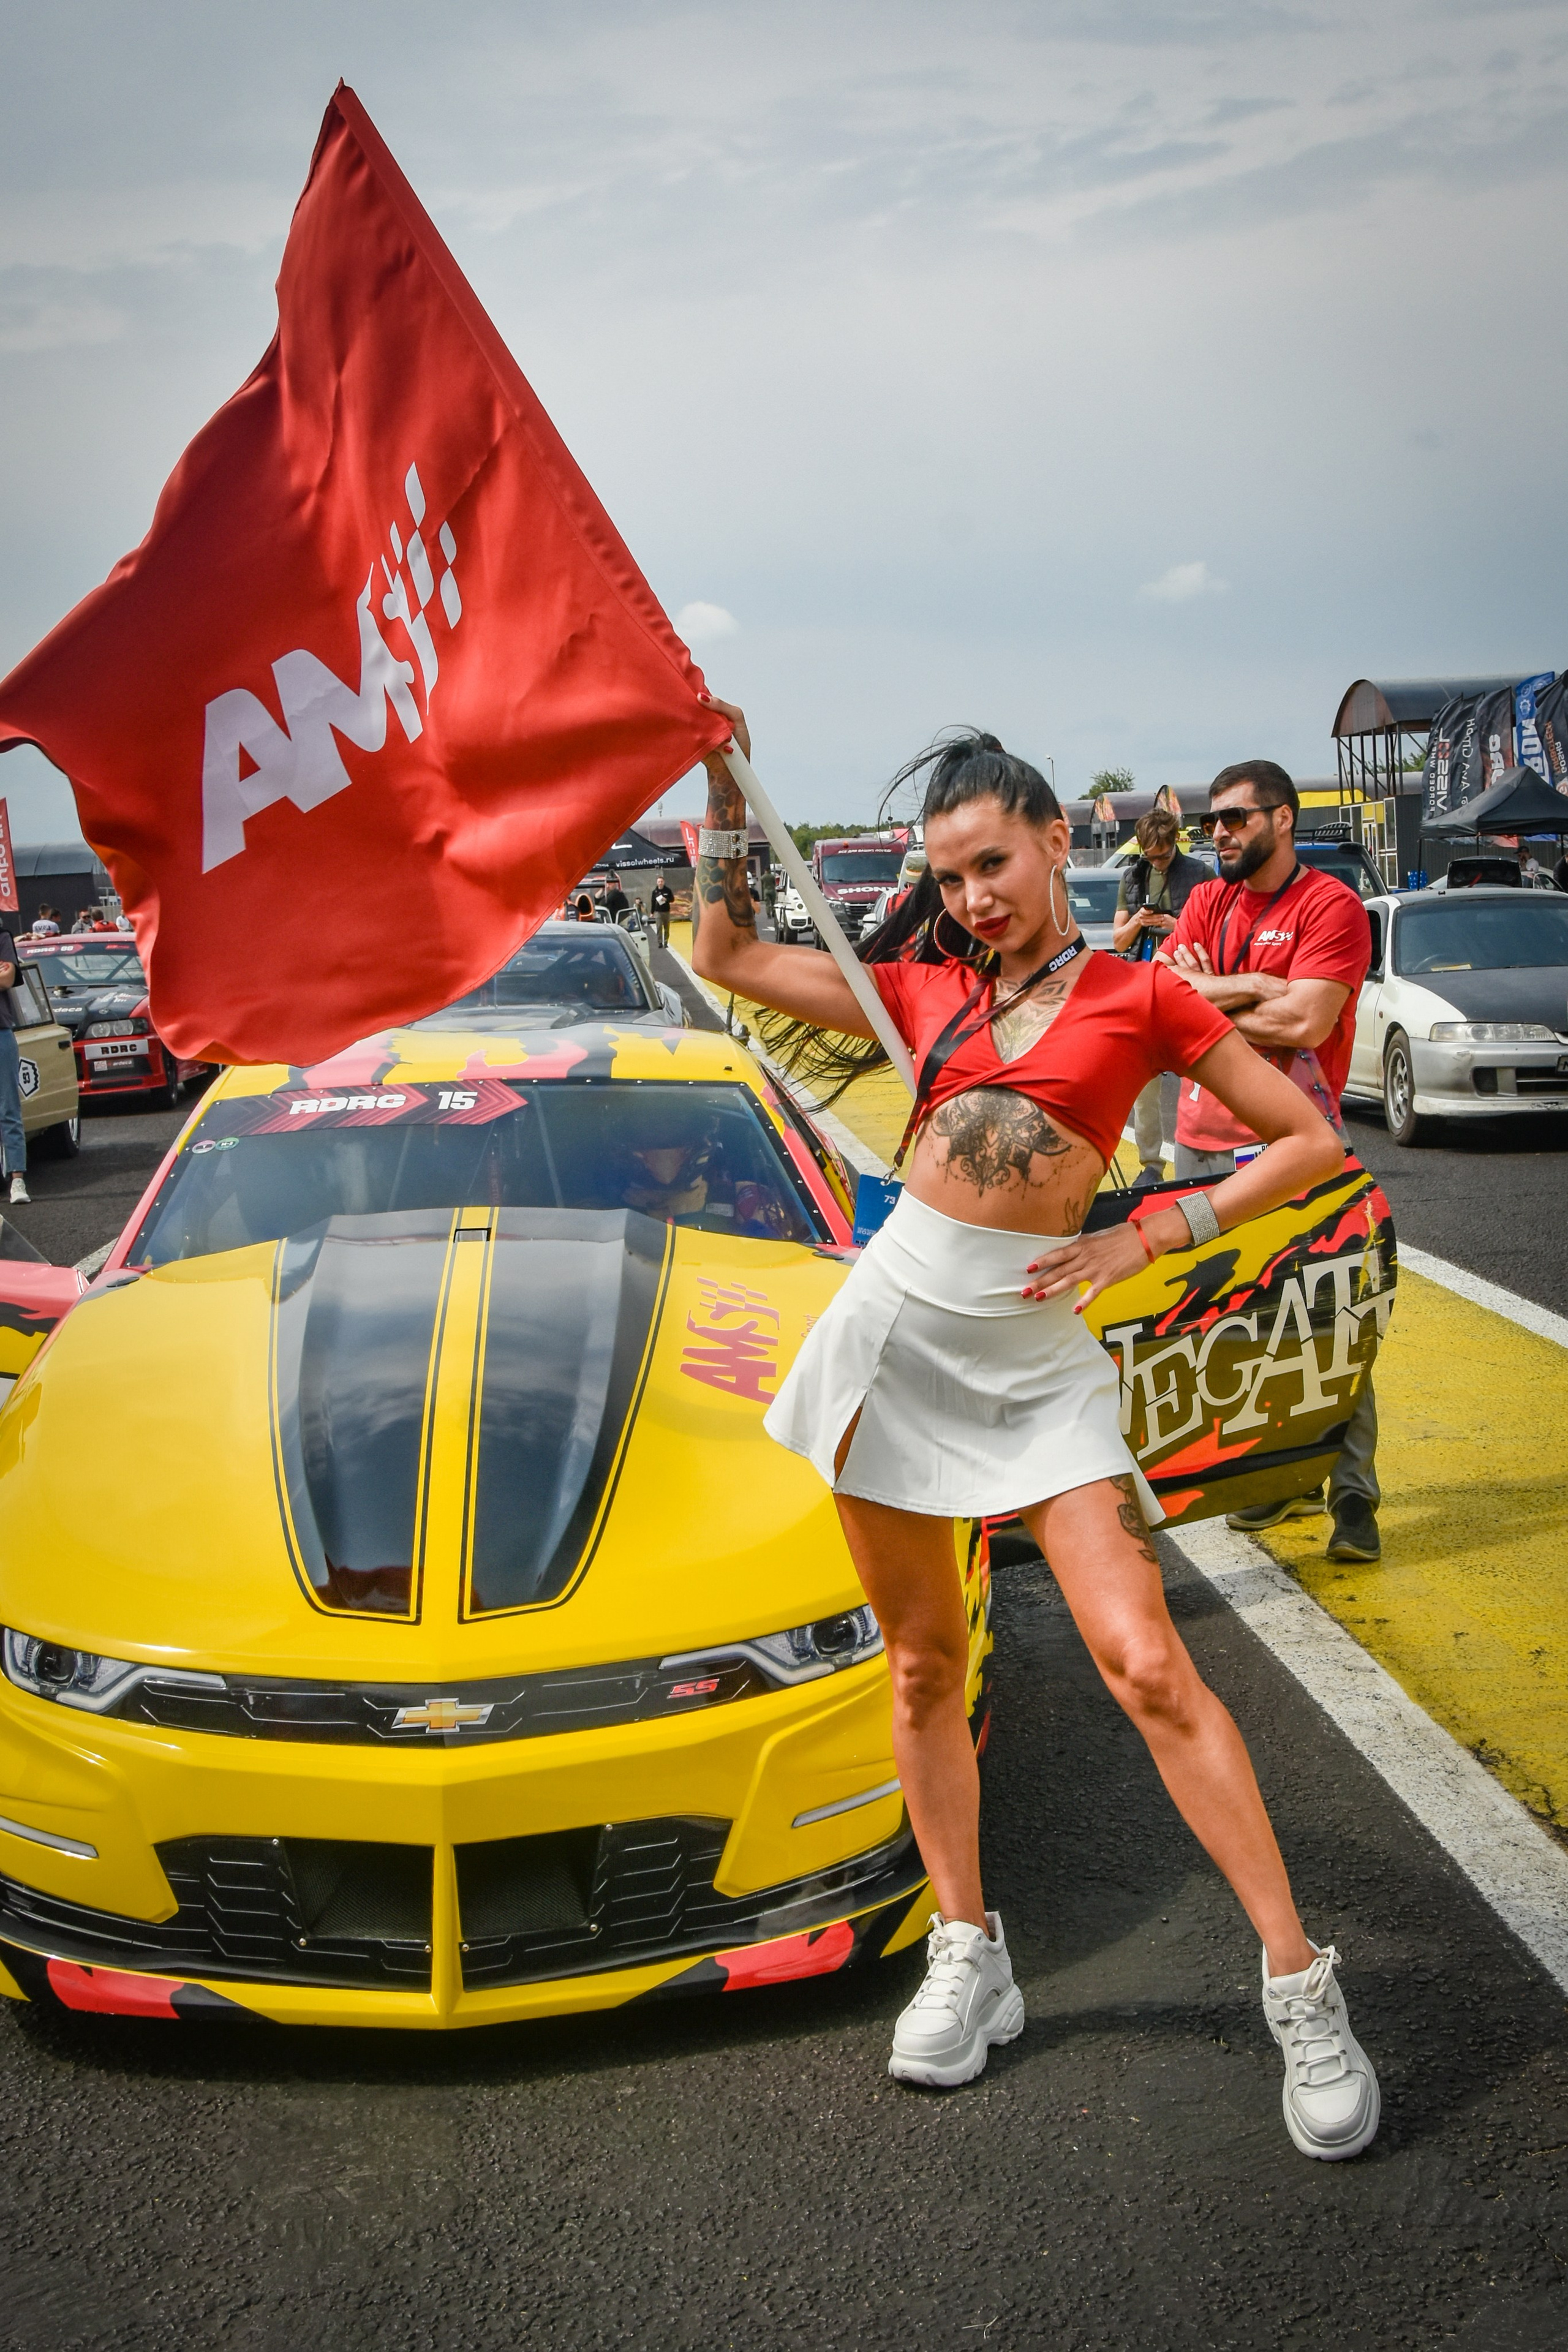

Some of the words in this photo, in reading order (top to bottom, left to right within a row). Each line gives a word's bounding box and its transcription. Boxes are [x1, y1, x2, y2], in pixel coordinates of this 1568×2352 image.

[616, 857, 674, 867] vissolwheels.ru
[1049, 945, 1078, 972] RDRC
[100, 1044, 137, 1055] RDRC
[288, 1094, 407, 1115] RDRC
[437, 1091, 478, 1110] 15
[884, 1194, 896, 1205] 73
[667, 1678, 720, 1699] SS
